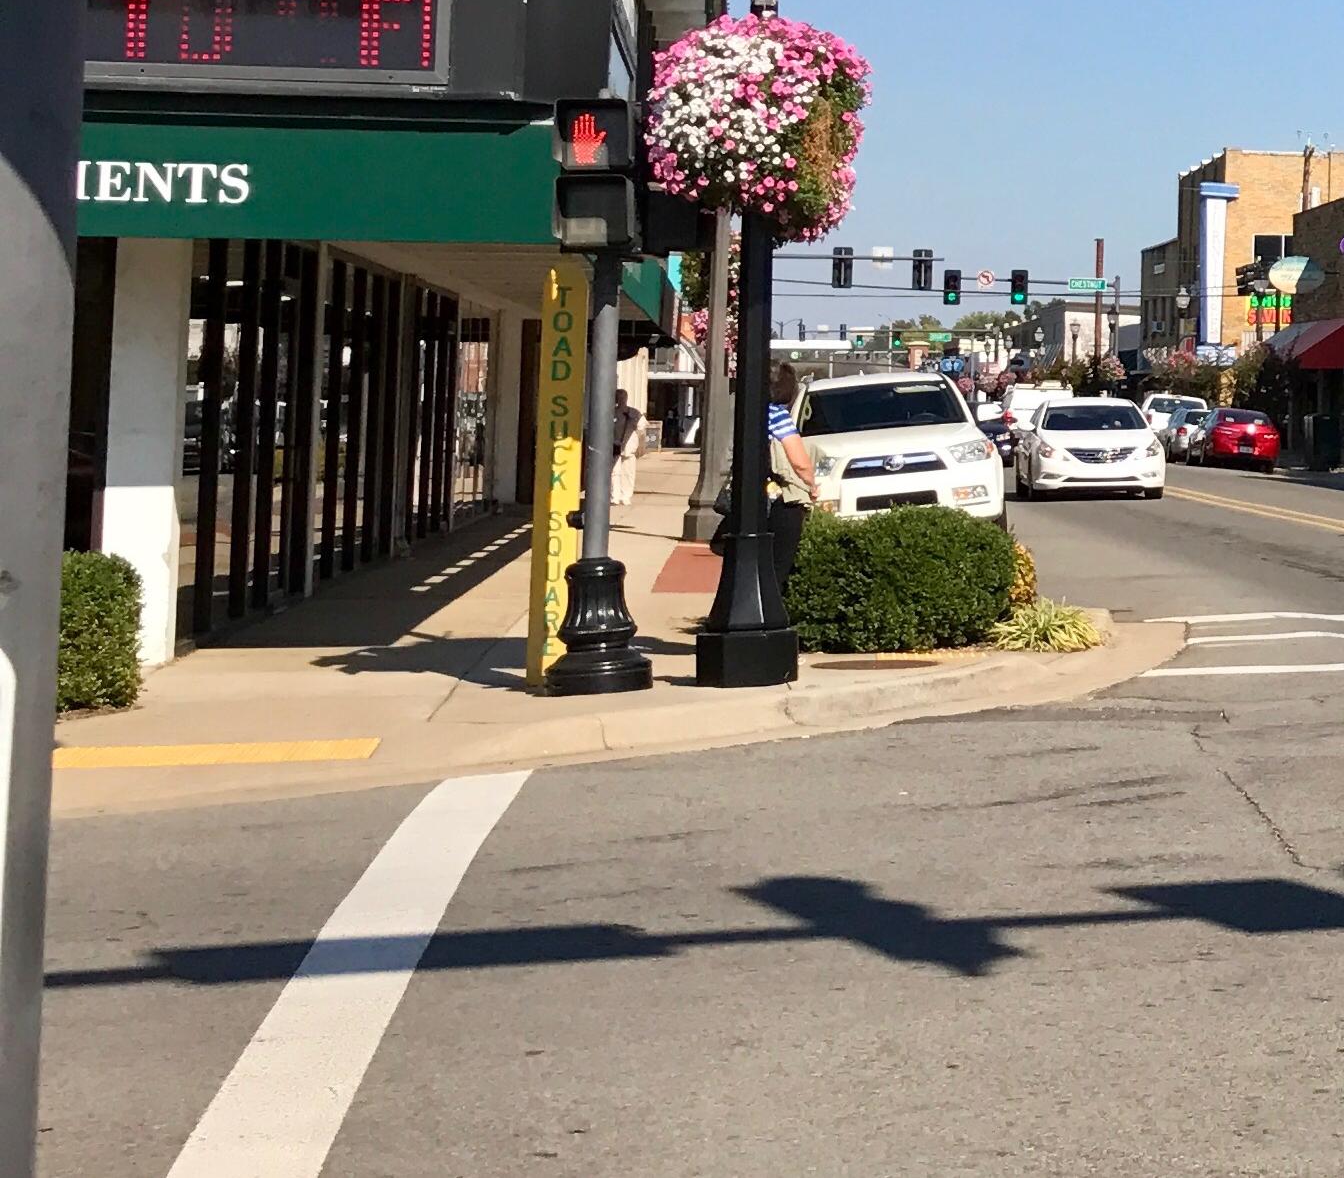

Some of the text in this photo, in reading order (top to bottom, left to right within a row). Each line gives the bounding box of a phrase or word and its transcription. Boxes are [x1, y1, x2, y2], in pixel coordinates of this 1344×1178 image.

[551, 286, 574, 382] TOAD
[549, 395, 573, 491] SUCK
[543, 510, 563, 657] SQUARE
